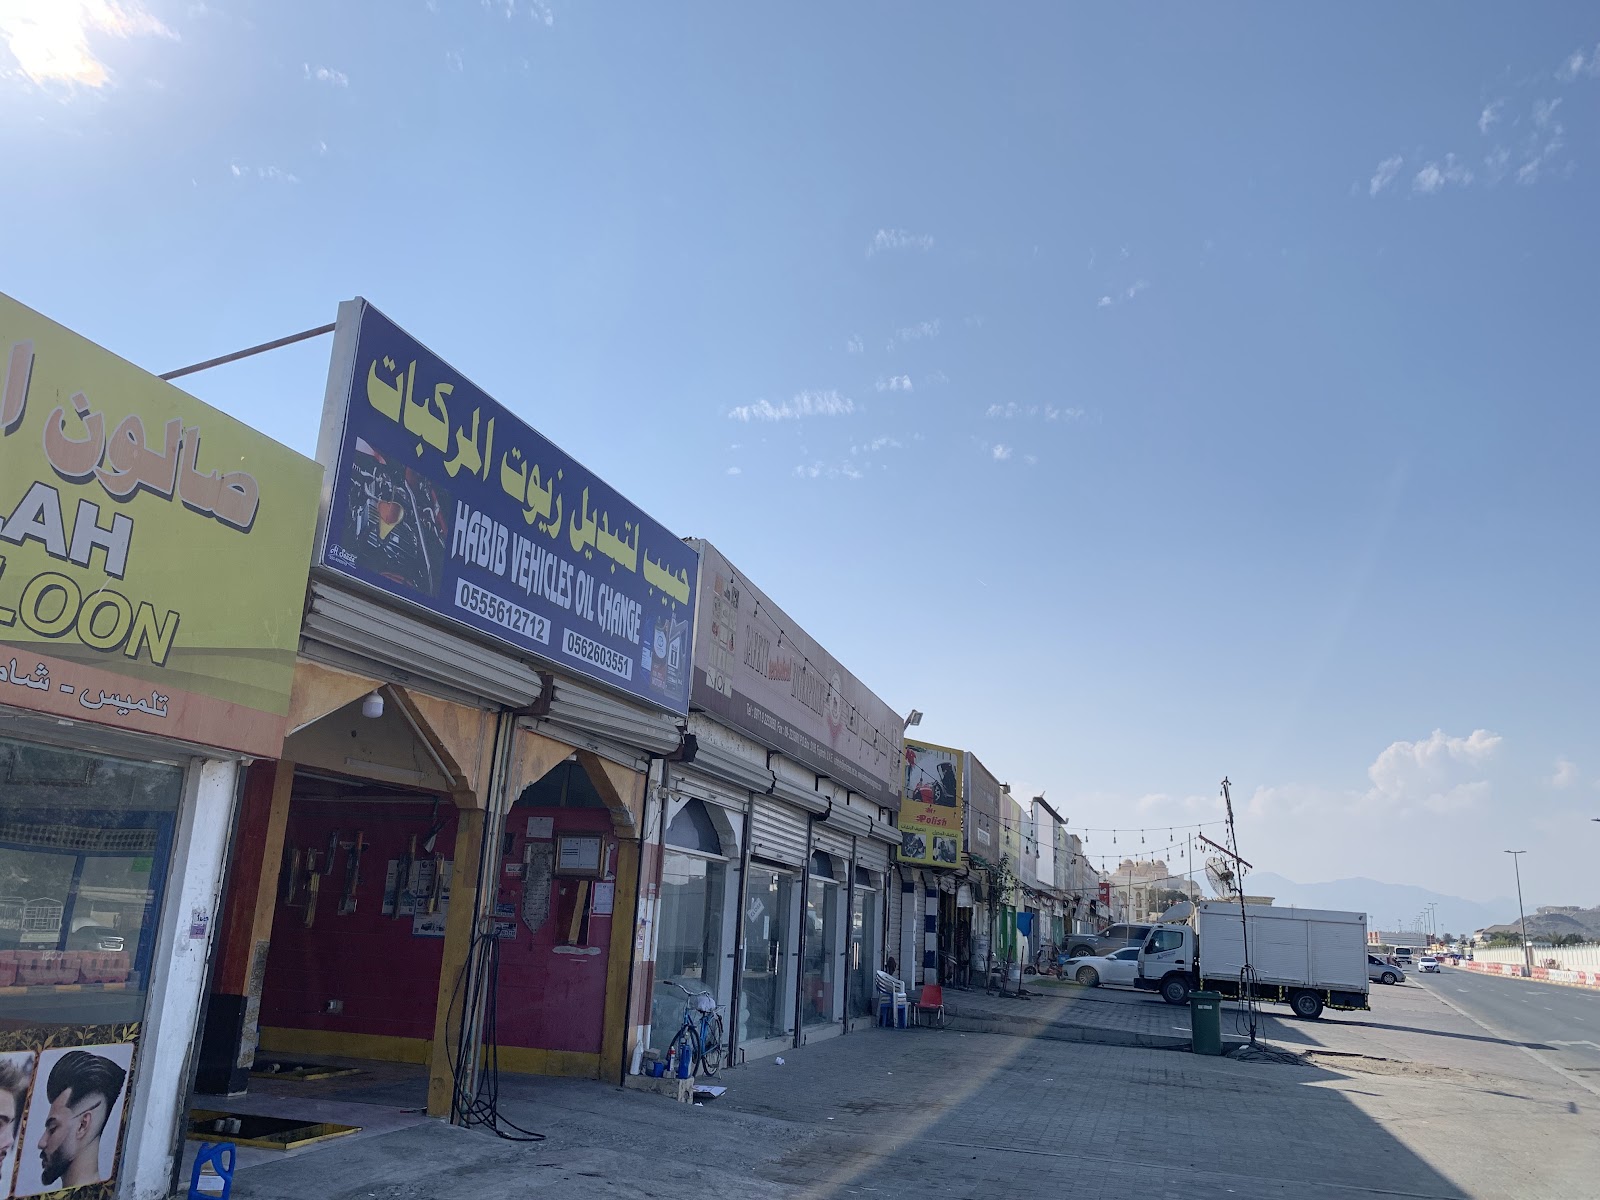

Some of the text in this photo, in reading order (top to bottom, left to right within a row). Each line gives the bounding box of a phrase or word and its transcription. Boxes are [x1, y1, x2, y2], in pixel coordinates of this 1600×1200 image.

[44, 391, 259, 534] صالون
[366, 354, 691, 610] حبيب لتبديل زيوت المركبات
[0, 480, 134, 581] AH
[451, 500, 642, 645] HABIB VEHICLES OIL CHANGE
[460, 583, 545, 641] 0555612712
[567, 632, 629, 676] 0562603551
[79, 688, 170, 718] تلميس
[917, 814, 948, 827] Polish
